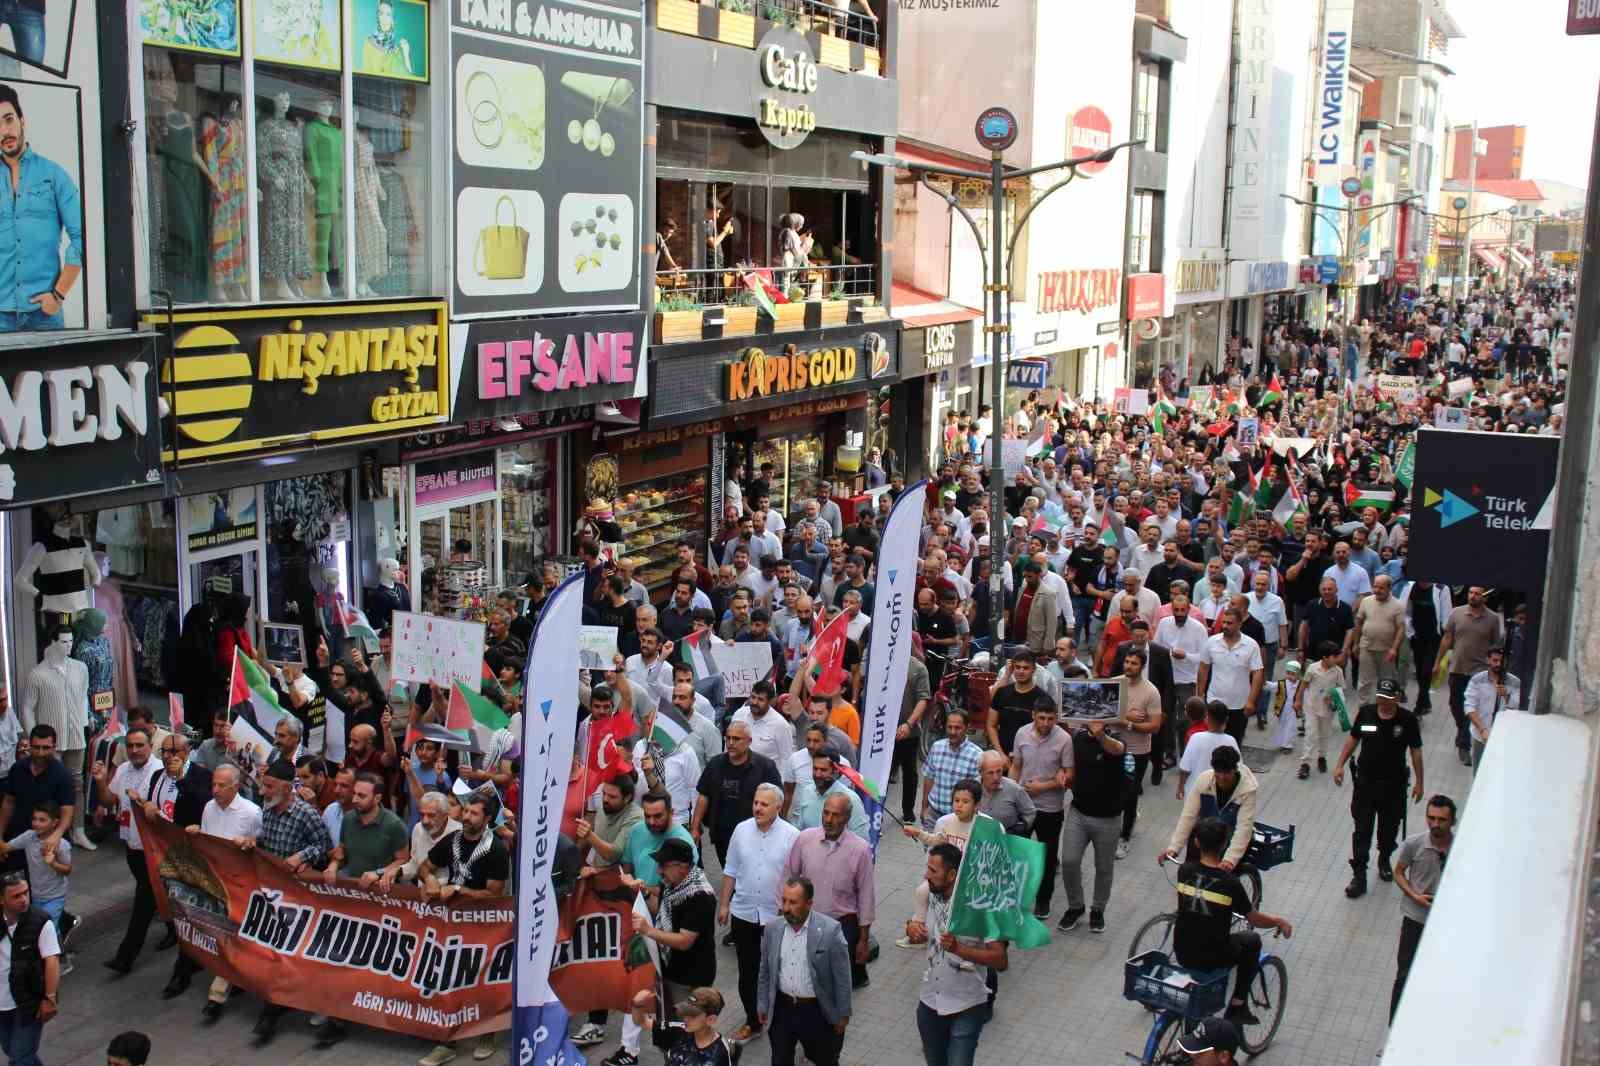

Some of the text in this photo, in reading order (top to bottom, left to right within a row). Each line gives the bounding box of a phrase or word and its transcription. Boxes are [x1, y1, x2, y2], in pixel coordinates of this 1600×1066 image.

[761, 43, 818, 93] Cafe
[258, 319, 438, 396] NİŞANTAŞI
[1009, 366, 1042, 384] KVK
[371, 384, 438, 422] GİYİM
[416, 470, 458, 492] EFSANE
[1485, 496, 1527, 513] Türk
[1484, 514, 1535, 531] Telek
[869, 704, 888, 759] Türk
[308, 884, 371, 902] ALİMLER
[304, 909, 418, 982] KUDÜS
[410, 926, 489, 999] İÇİN
[352, 990, 383, 1012] AĞRI
